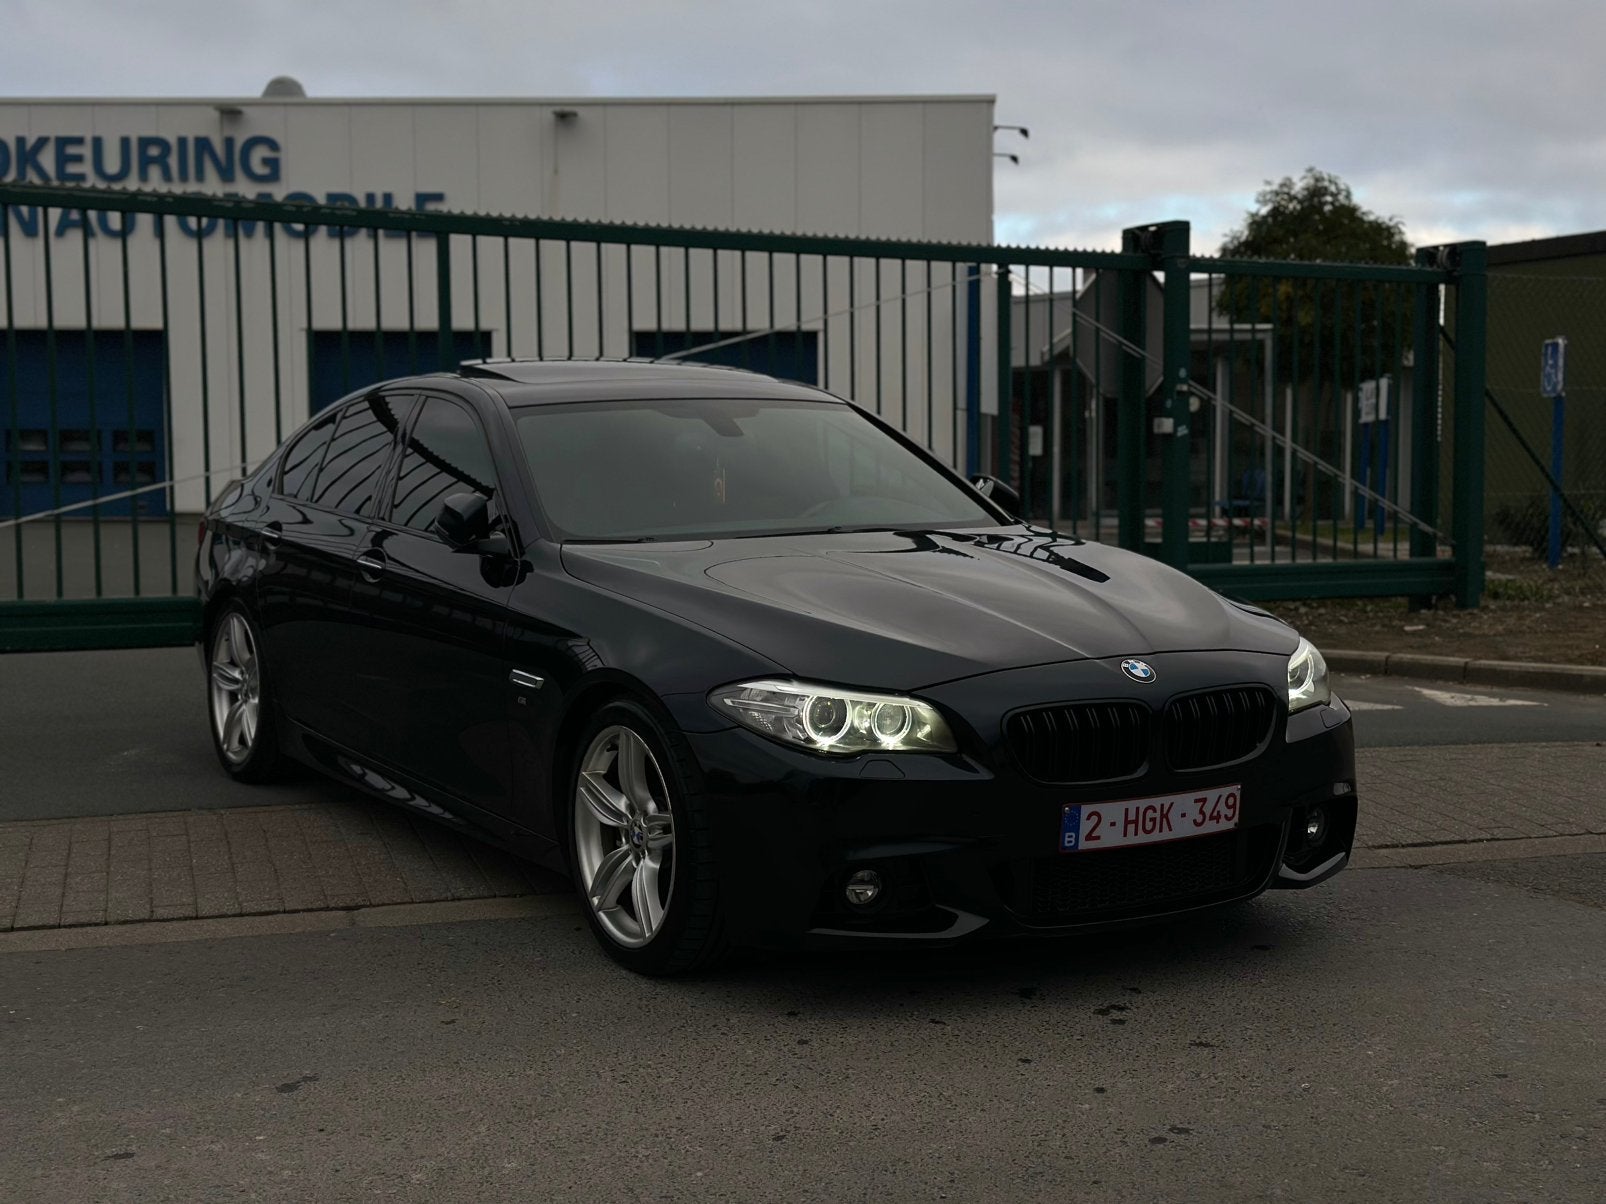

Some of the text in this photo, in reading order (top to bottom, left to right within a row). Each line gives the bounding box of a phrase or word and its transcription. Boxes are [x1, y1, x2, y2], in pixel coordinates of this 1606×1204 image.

[0, 135, 281, 184] KEURING
[1065, 832, 1076, 847] B
[1084, 792, 1237, 841] 2-HGK-349
